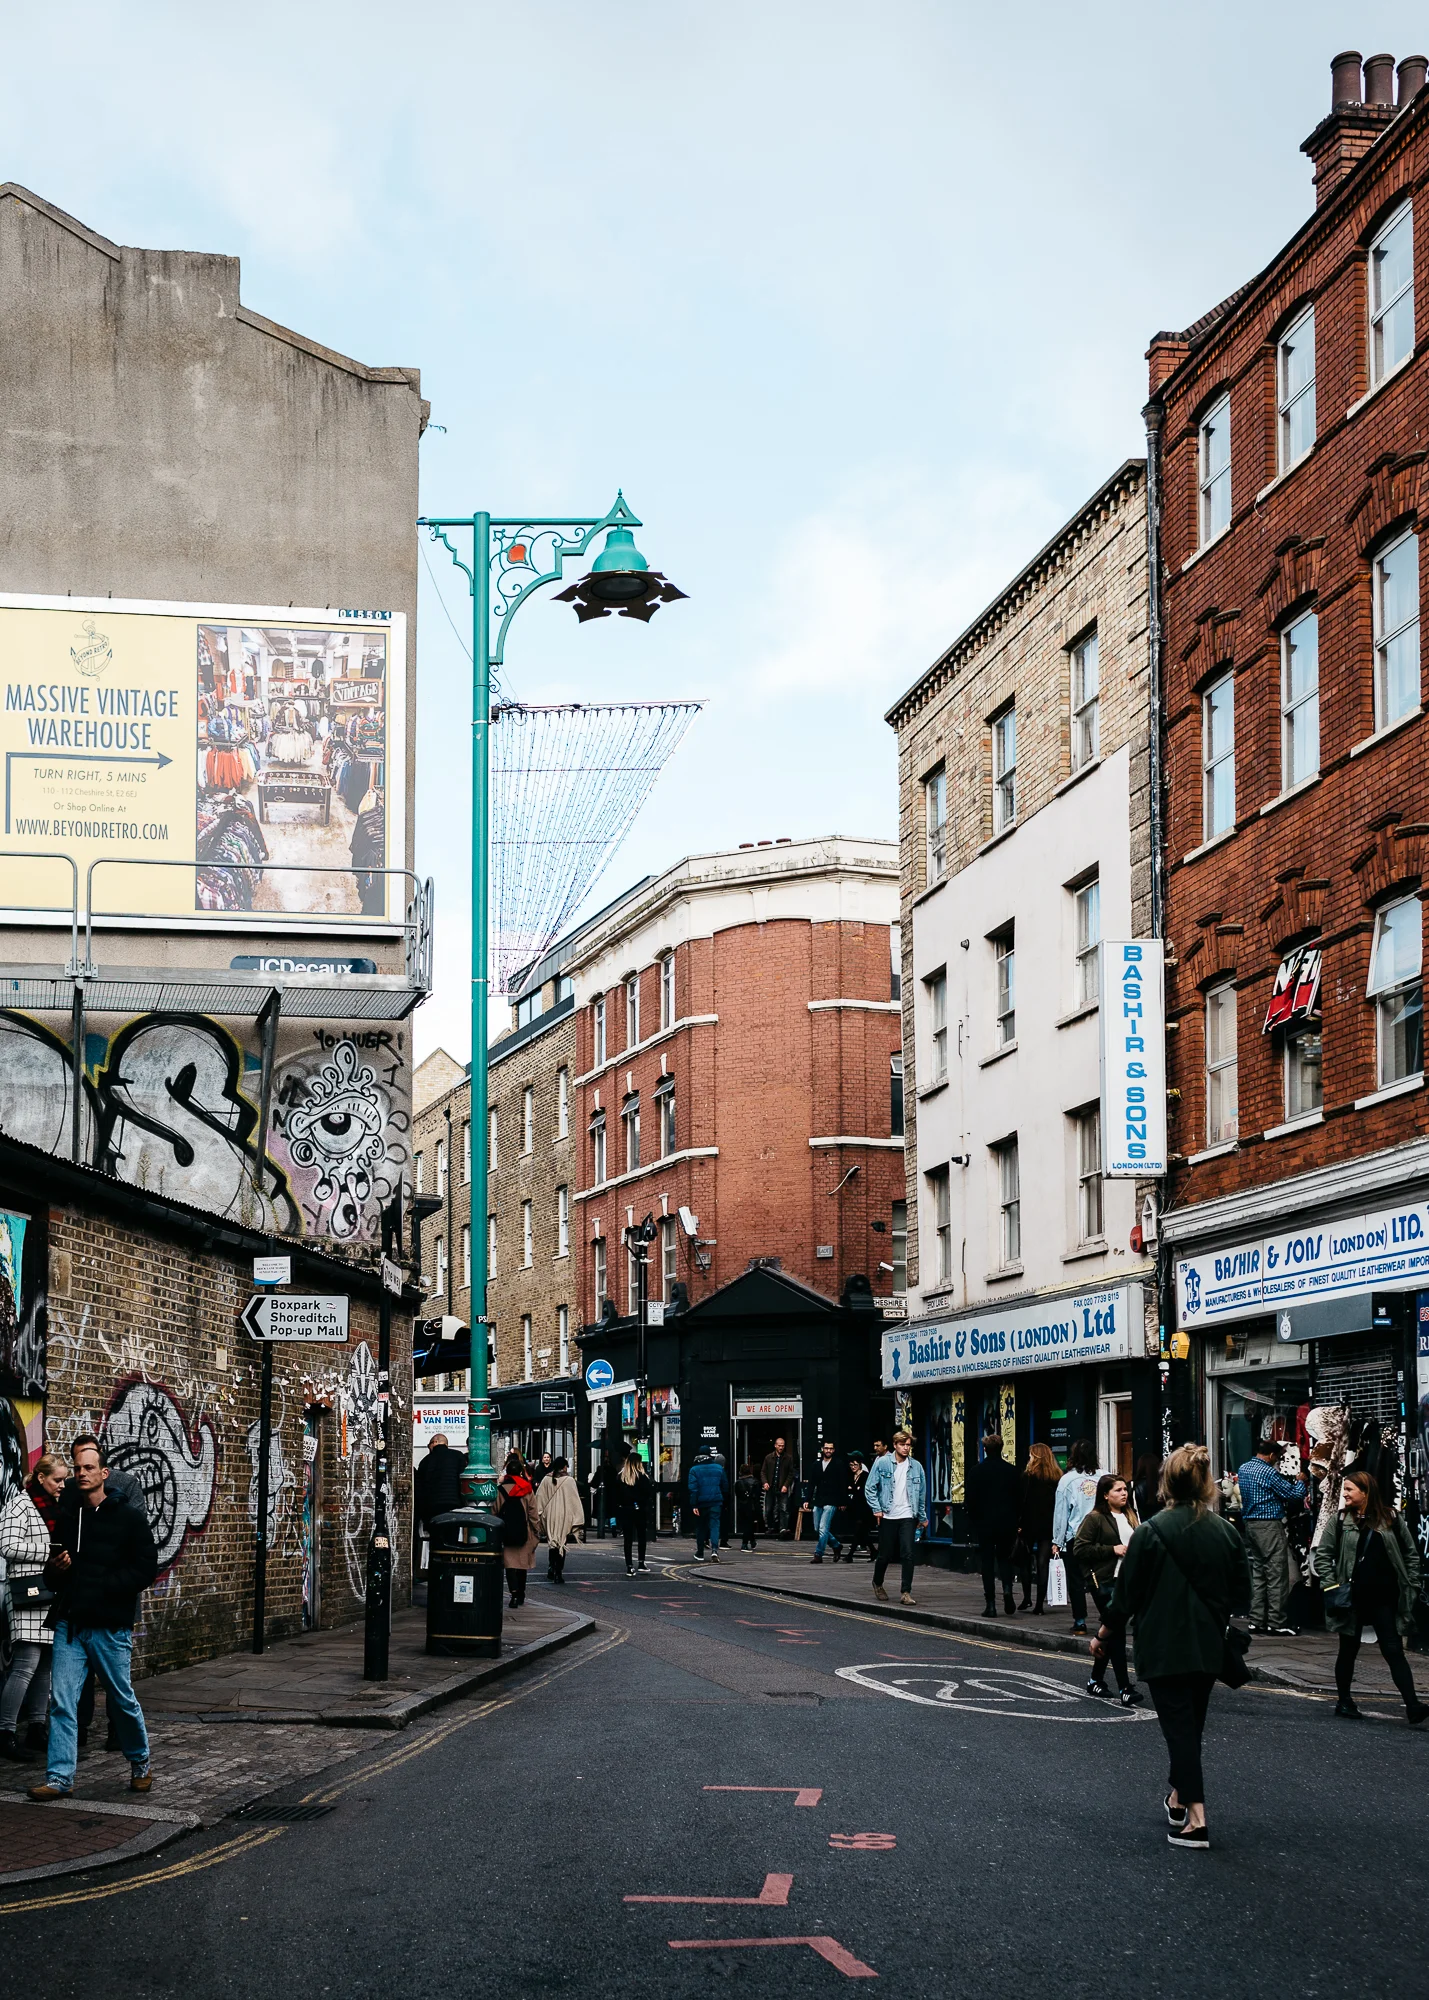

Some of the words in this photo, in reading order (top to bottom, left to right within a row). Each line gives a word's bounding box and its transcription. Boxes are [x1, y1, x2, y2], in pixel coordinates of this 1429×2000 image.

[339, 609, 392, 620] 015501
[5, 684, 90, 714] MASSIVE
[97, 688, 179, 717] VINTAGE
[333, 682, 379, 701] VINTAGE
[28, 718, 152, 750] WAREHOUSE
[34, 768, 64, 780] TURN
[67, 770, 102, 783] RIGHT,
[107, 772, 113, 782] 5
[117, 772, 147, 783] MINS
[42, 787, 55, 795] 110
[61, 788, 73, 796] 112
[74, 788, 104, 797] Cheshire
[116, 790, 124, 798] E2
[53, 802, 64, 811] Or
[67, 803, 87, 814] Shop
[89, 804, 115, 813] Online
[117, 805, 127, 813] At
[15, 818, 169, 840] WWW.BEYONDRETRO.COM
[253, 958, 353, 973] JCDecaux
[1122, 946, 1145, 1052] BASHIR
[1126, 1062, 1148, 1079] &
[1125, 1087, 1147, 1159] SONS
[1215, 1249, 1260, 1281] BASHIR
[1267, 1245, 1279, 1268] &
[1285, 1234, 1323, 1265] SONS
[1329, 1222, 1387, 1260] (LONDON)
[1392, 1213, 1424, 1243] LTD.
[1205, 1290, 1247, 1307] MANUFACTURERS
[1247, 1289, 1251, 1297] &
[1253, 1281, 1295, 1297] WHOLESALERS
[1298, 1279, 1306, 1289] OF
[1309, 1274, 1330, 1287] FINEST
[1331, 1268, 1357, 1282] QUALITY
[1358, 1260, 1406, 1277] LEATHERWEAR
[270, 1300, 321, 1314] Boxpark
[1074, 1300, 1083, 1308] FAX
[1084, 1298, 1093, 1307] 020
[270, 1313, 337, 1324] Shoreditch
[270, 1325, 312, 1337] Pop-up
[317, 1325, 343, 1336] Mall
[908, 1335, 951, 1365] Bashir
[955, 1331, 967, 1358] &
[970, 1328, 1006, 1356] Sons
[1083, 1304, 1116, 1338] Ltd
[912, 1366, 956, 1379] MANUFACTURERS
[957, 1366, 961, 1374] &
[962, 1359, 1001, 1373] WHOLESALERS
[1003, 1357, 1011, 1367] OF
[1012, 1355, 1033, 1366] FINEST
[1034, 1351, 1060, 1364] QUALITY
[1061, 1343, 1110, 1359] LEATHERWEAR
[423, 1416, 442, 1424] VAN
[891, 1678, 1082, 1702] 20
